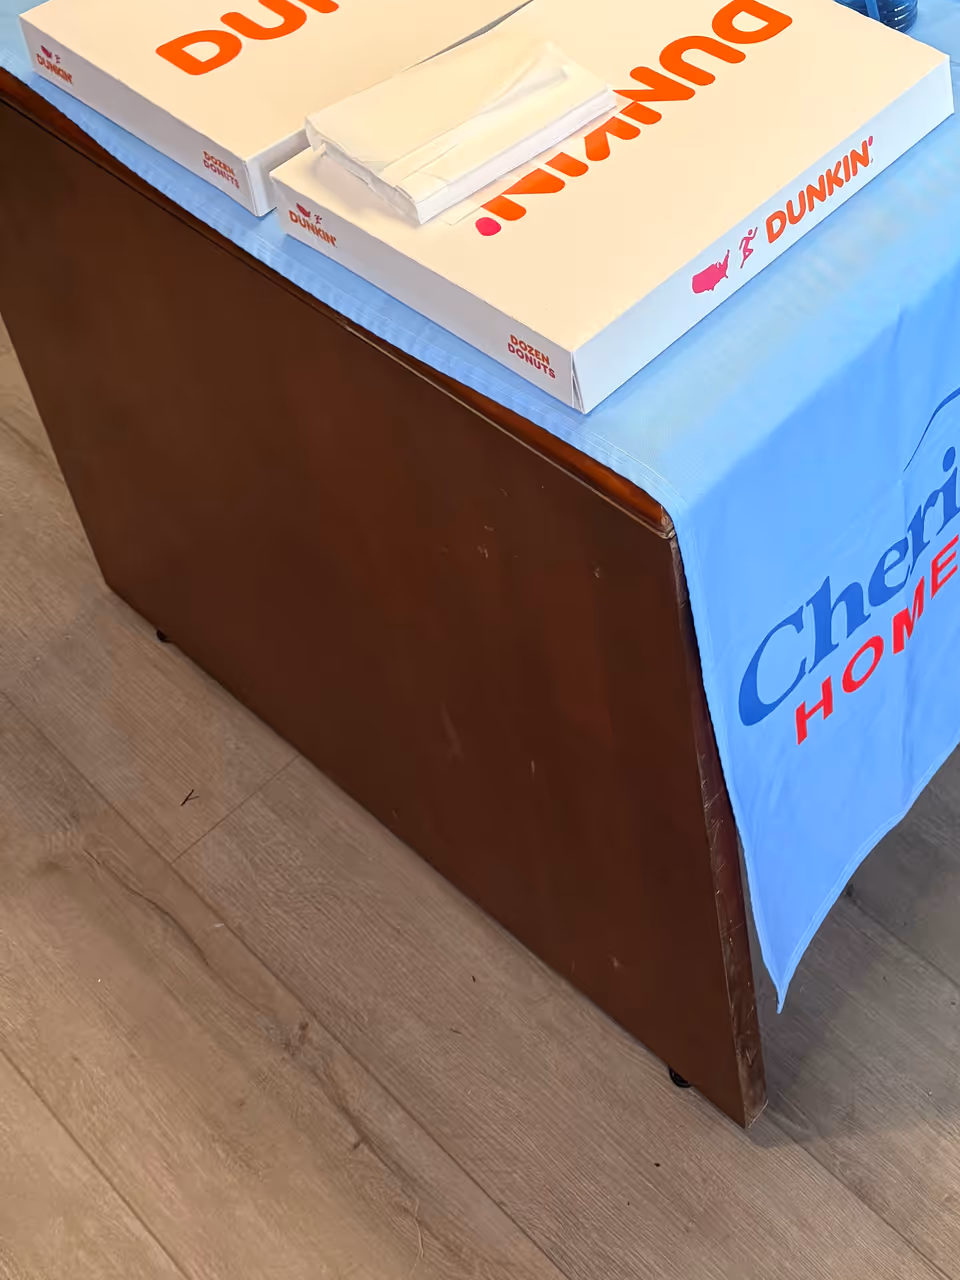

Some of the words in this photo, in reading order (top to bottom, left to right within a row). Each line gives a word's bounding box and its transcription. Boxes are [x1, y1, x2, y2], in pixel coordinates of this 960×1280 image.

[203, 150, 236, 177] DOZEN
[203, 159, 240, 189] DONUTS
[765, 135, 874, 244] DUNKIN'
[507, 342, 556, 379] DONUTS
[510, 333, 550, 366] DOZEN
[794, 534, 960, 746] HOME
